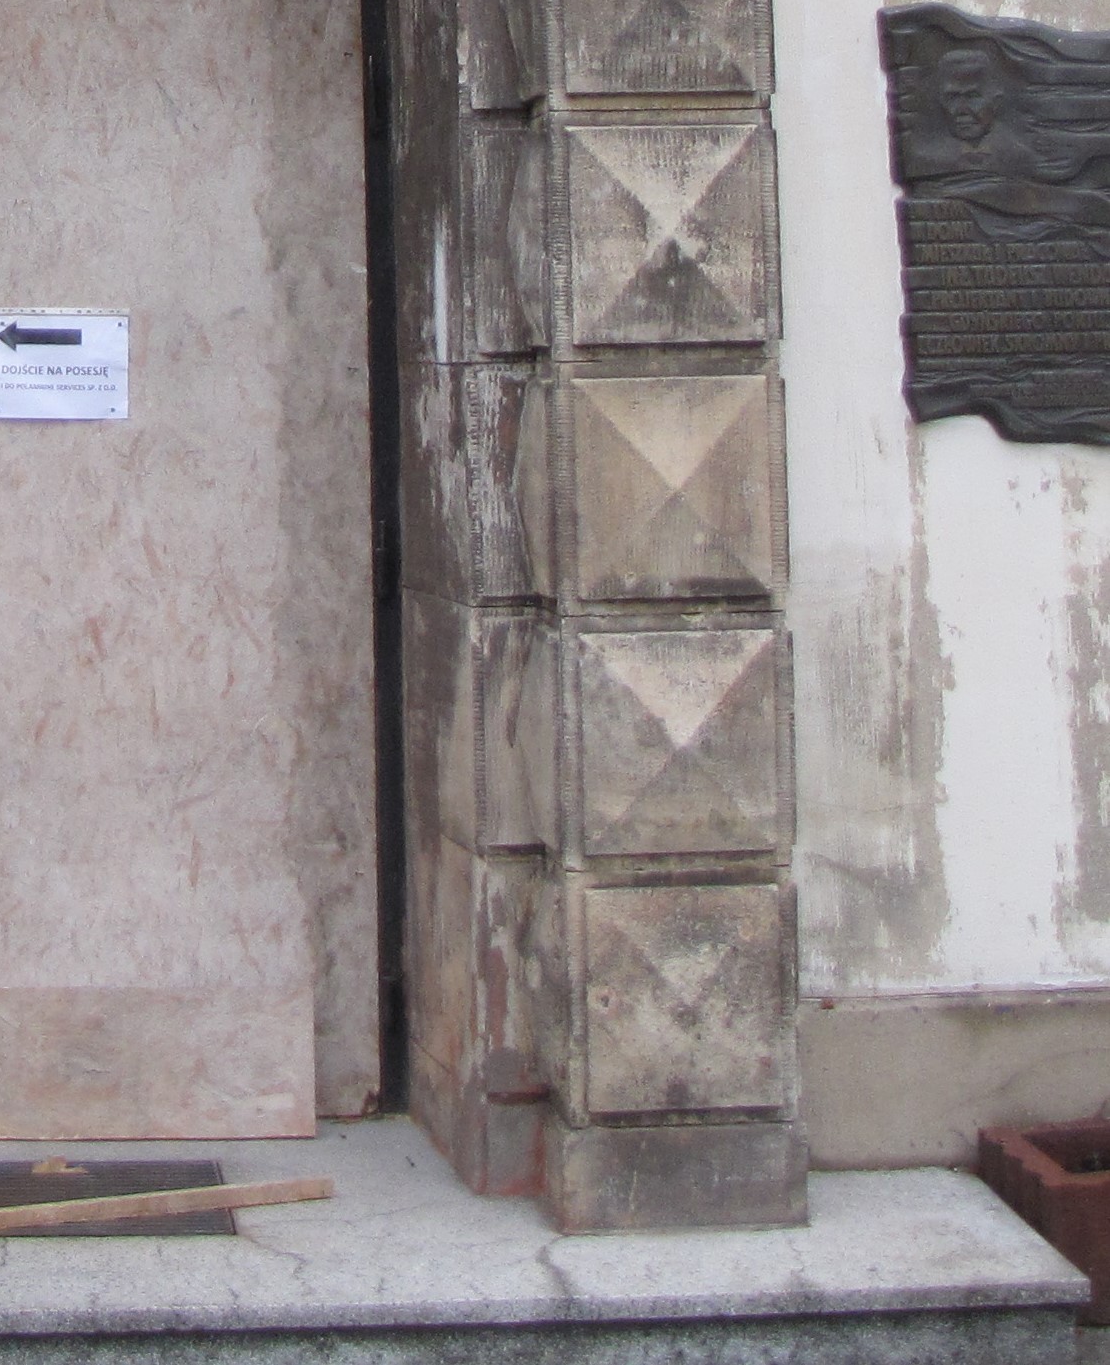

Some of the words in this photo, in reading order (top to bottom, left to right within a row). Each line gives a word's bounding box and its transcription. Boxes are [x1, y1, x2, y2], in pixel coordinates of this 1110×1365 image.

[1, 364, 44, 375] DOJŚCIE
[47, 366, 63, 375] NA
[66, 366, 109, 378] POSESJĘ
